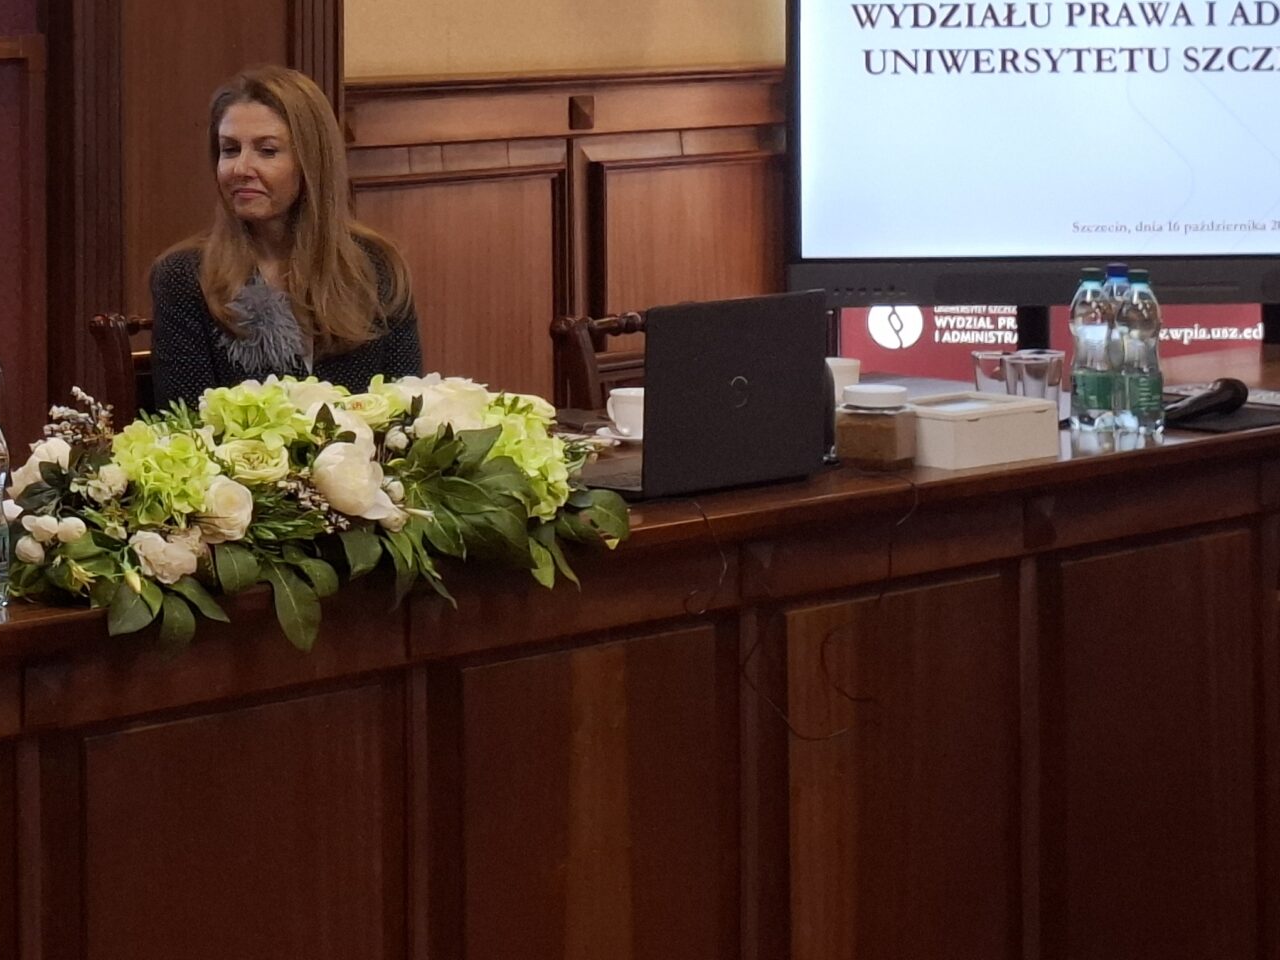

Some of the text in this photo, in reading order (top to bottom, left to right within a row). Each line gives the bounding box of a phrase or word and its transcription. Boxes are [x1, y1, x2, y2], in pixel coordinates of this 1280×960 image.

[851, 2, 1052, 29] WYDZIAŁU
[1066, 1, 1194, 28] PRAWA
[1207, 1, 1217, 26] I
[863, 46, 1280, 75] UNIWERSYTETU SZCZ
[1135, 220, 1163, 232] dnia
[998, 316, 1018, 329] PR
